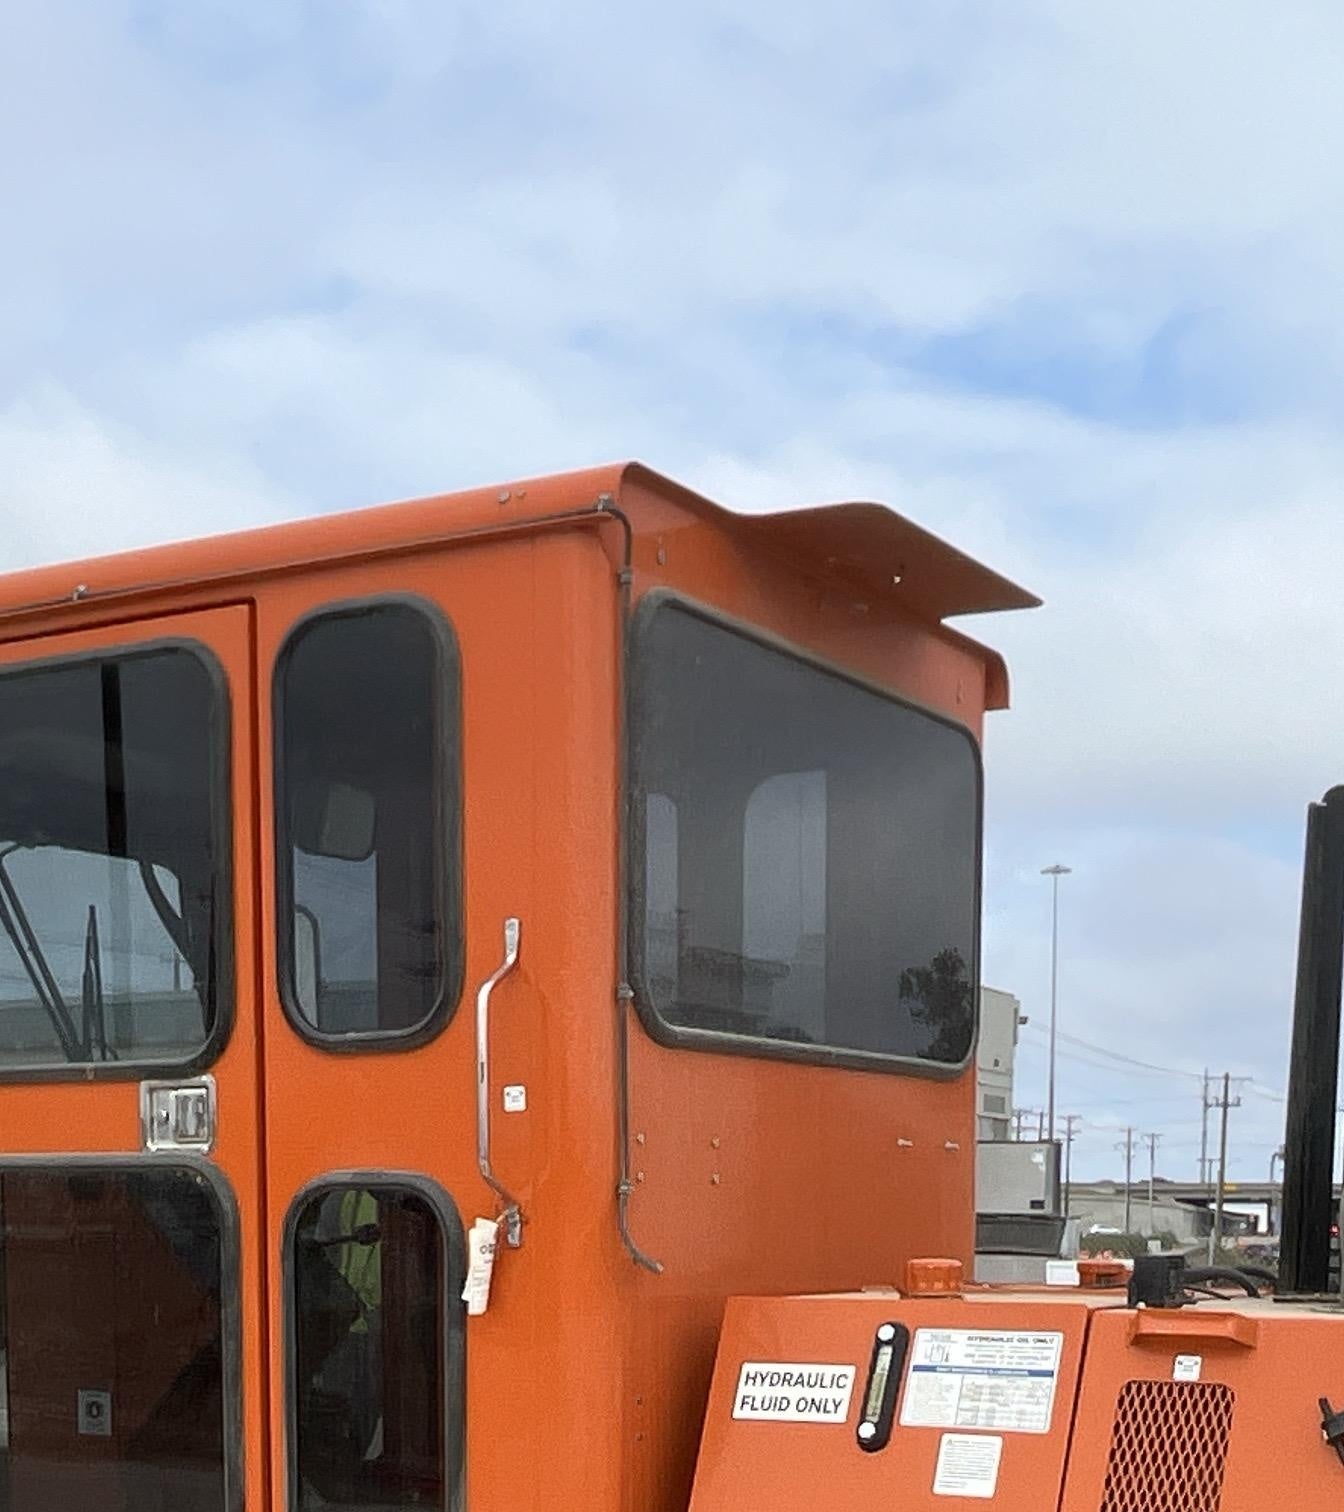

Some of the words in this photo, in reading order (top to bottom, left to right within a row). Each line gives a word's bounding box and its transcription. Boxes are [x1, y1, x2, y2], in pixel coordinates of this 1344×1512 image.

[744, 1370, 849, 1389] HYDRAULIC
[739, 1394, 791, 1412] FLUID
[795, 1397, 844, 1414] ONLY
